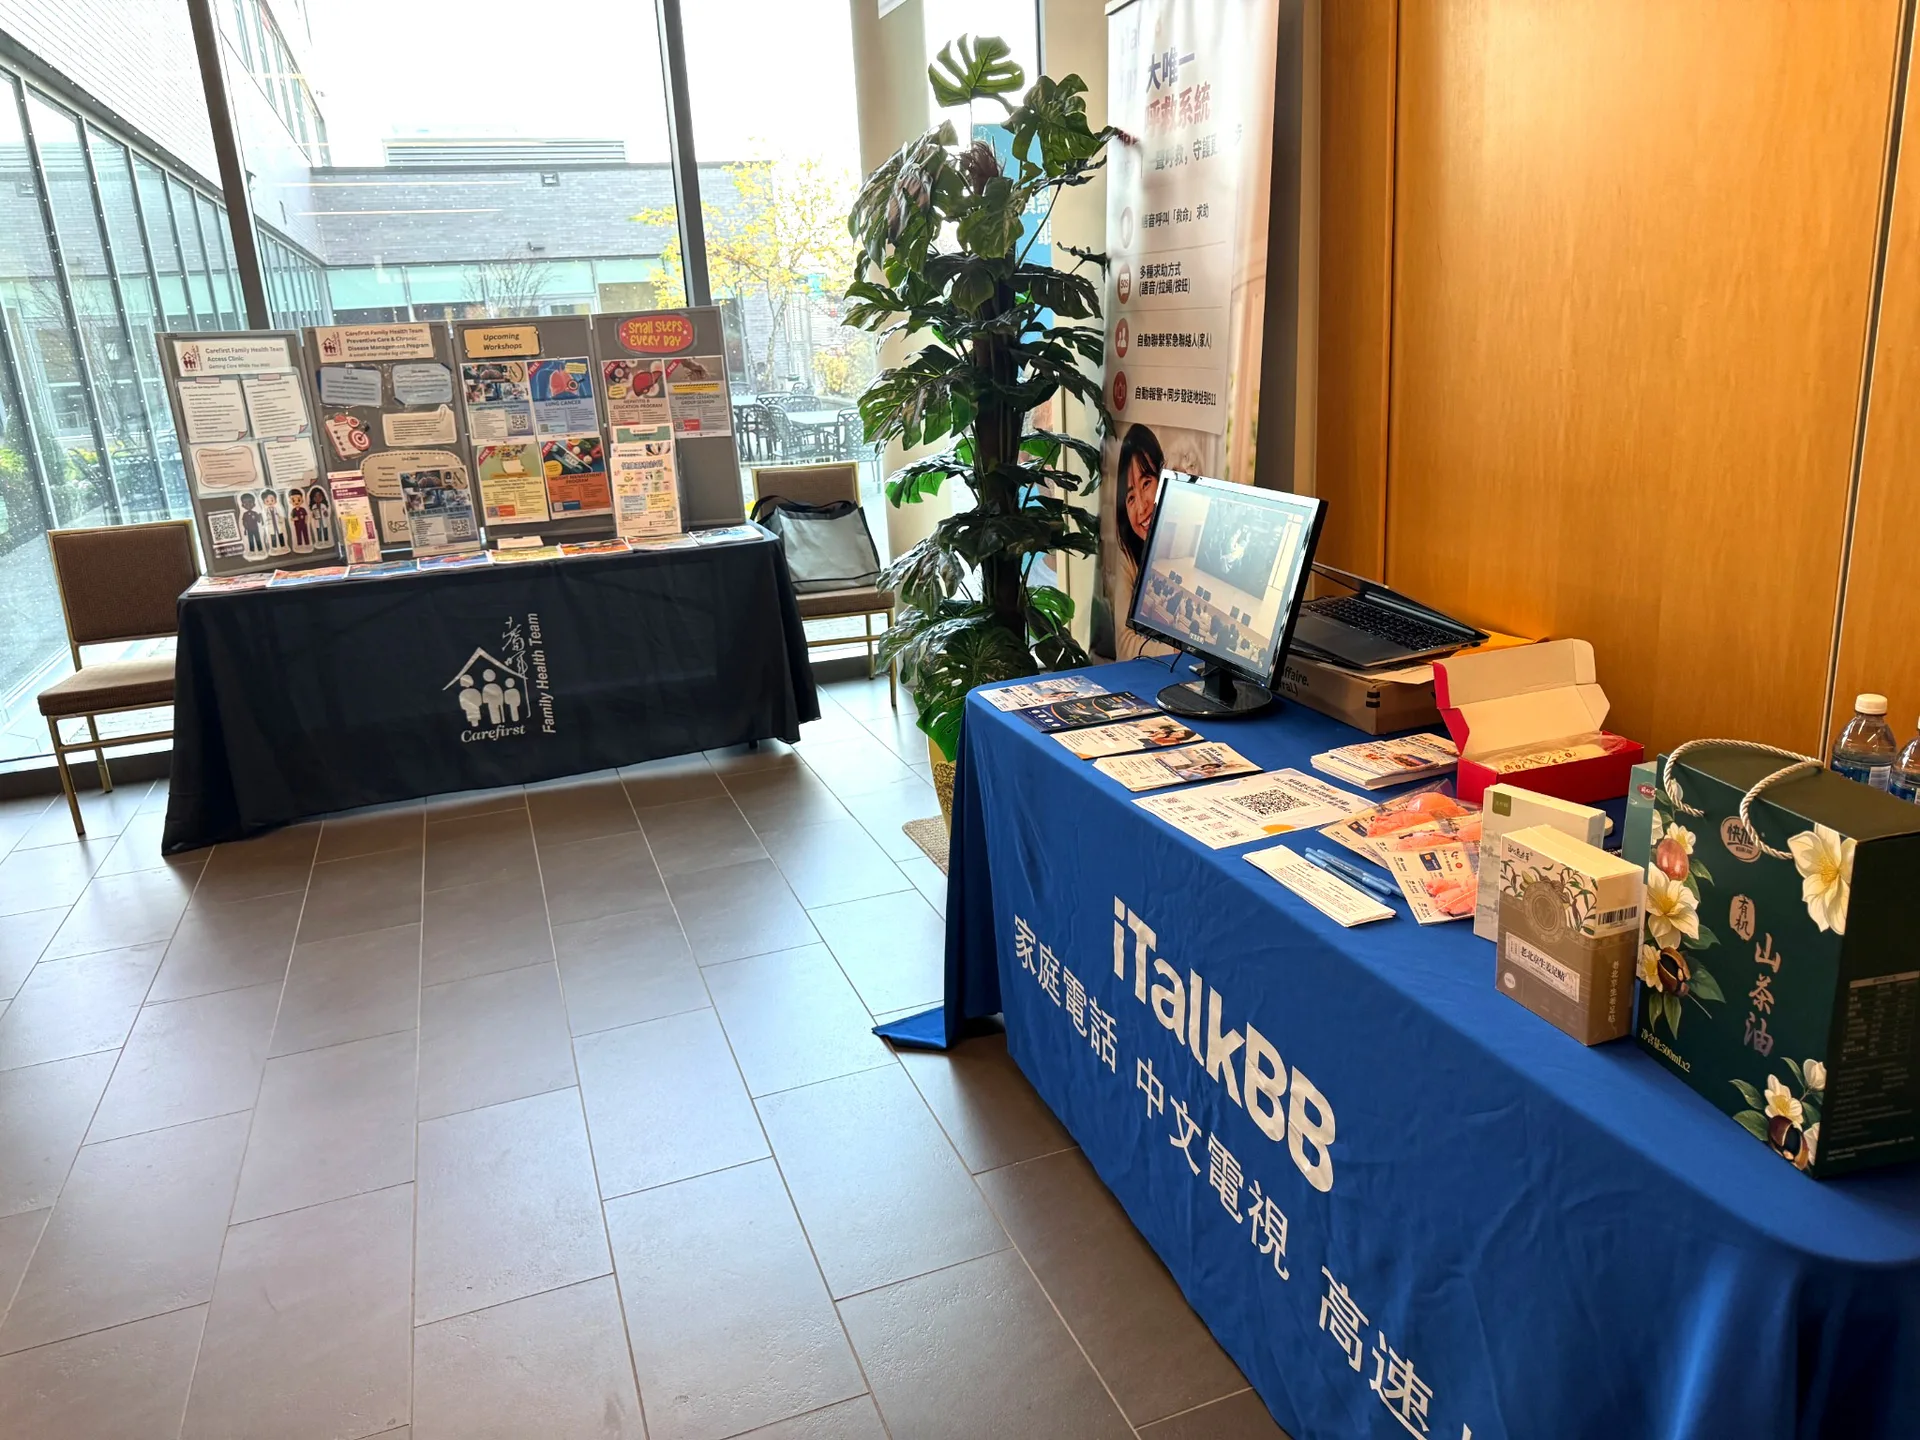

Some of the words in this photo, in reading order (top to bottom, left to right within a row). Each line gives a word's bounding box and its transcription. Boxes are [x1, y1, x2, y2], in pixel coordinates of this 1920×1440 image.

[483, 333, 520, 341] Upcoming
[483, 343, 522, 351] Workshops
[605, 362, 615, 375] FREE
[667, 362, 677, 373] FREE
[528, 613, 542, 646] Team
[531, 650, 549, 689] Health
[1284, 666, 1309, 687] ffaire.
[539, 692, 556, 733] Family
[461, 725, 527, 743] Carefirst
[1735, 898, 1750, 936] 有机
[1744, 932, 1781, 1057] 山茶油
[1113, 895, 1336, 1193] iTalkBB
[1013, 913, 1119, 1075] 家庭電話
[1136, 1055, 1291, 1282] 中文電視
[1318, 1264, 1472, 1440] 高速
